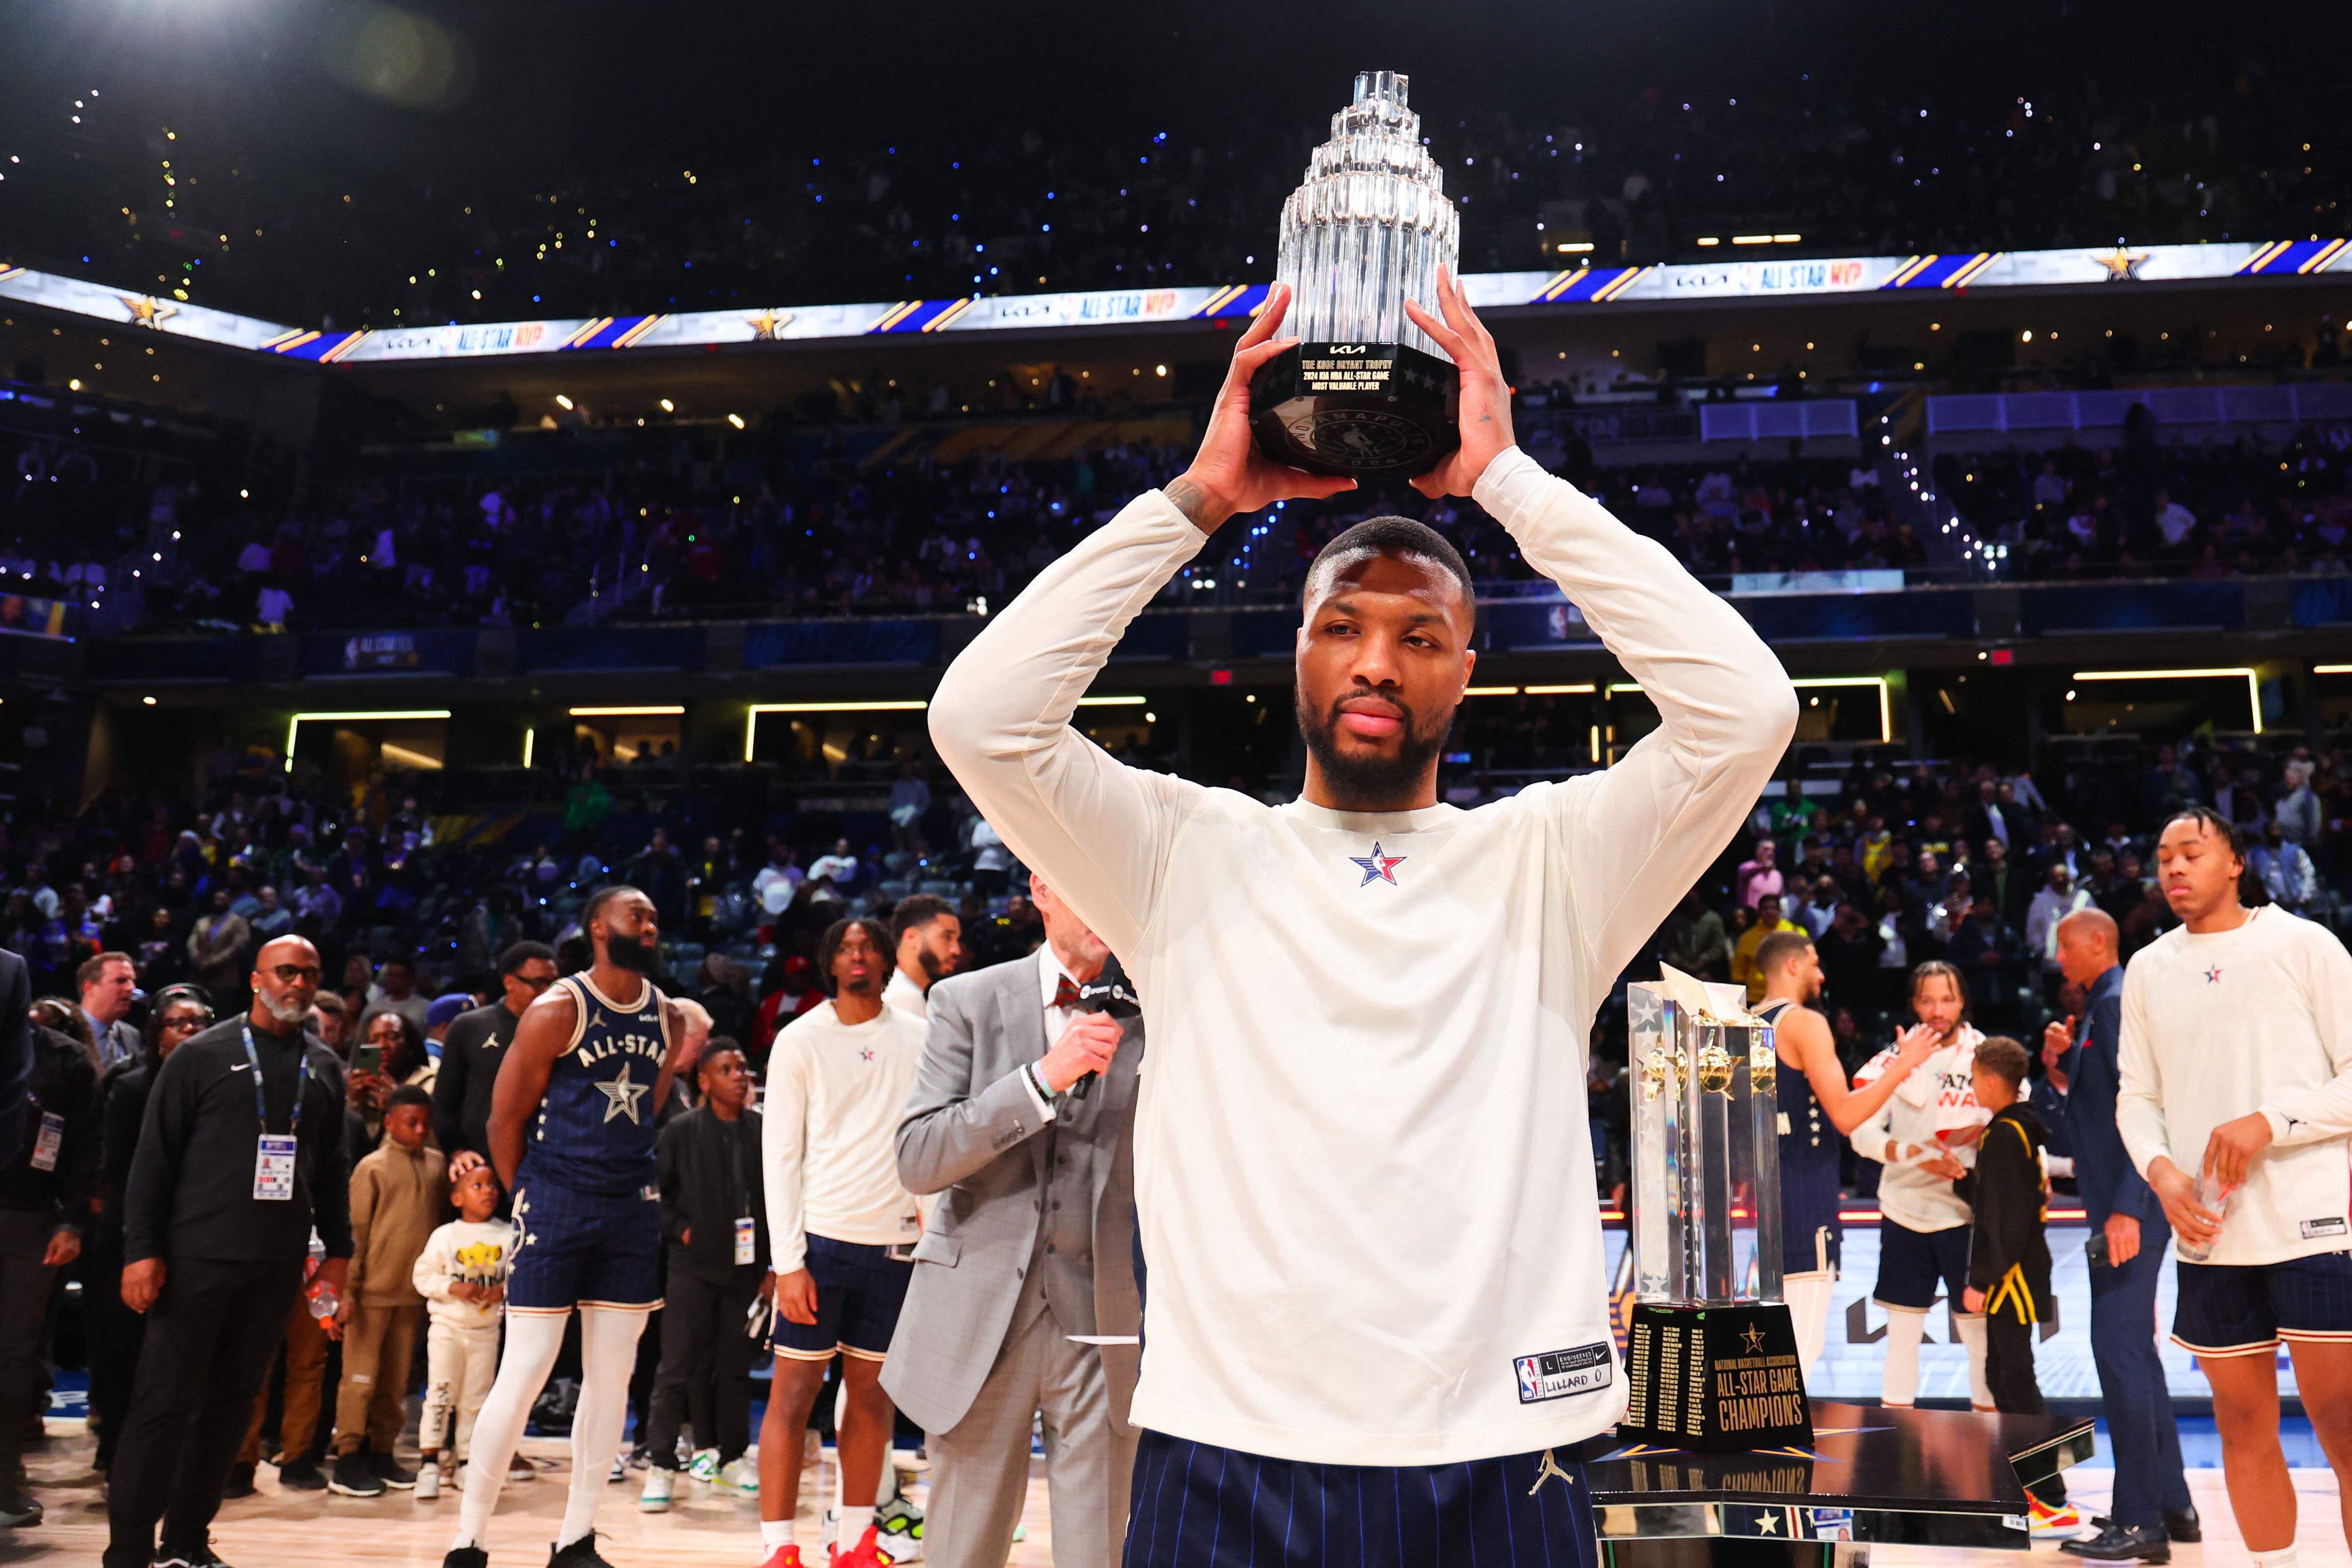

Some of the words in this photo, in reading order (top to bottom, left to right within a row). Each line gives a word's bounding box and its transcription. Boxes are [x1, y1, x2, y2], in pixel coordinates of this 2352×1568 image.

[1831, 261, 1862, 285] MVP
[1146, 292, 1176, 314] MVP
[1302, 360, 1315, 369] THE
[1317, 360, 1334, 369] KOBE
[1336, 360, 1363, 369] BRYANT
[1365, 360, 1392, 369] TROPHY
[1304, 372, 1318, 380] 2024
[1319, 371, 1329, 380] KIA
[1330, 371, 1342, 380] NBA
[1343, 371, 1371, 380] ALL-STAR
[1372, 371, 1389, 380] GAME
[1312, 382, 1328, 390] MOST
[1329, 382, 1356, 390] VALUABLE
[1358, 382, 1380, 390] PLAYER
[1546, 1362, 1553, 1370] L
[1559, 1352, 1591, 1362] ENGINEERED
[1546, 1375, 1587, 1392] LILLARD
[1717, 1370, 1767, 1397] ALL-STAR
[1769, 1367, 1799, 1393] GAME
[1719, 1394, 1803, 1432] CHAMPIONS
